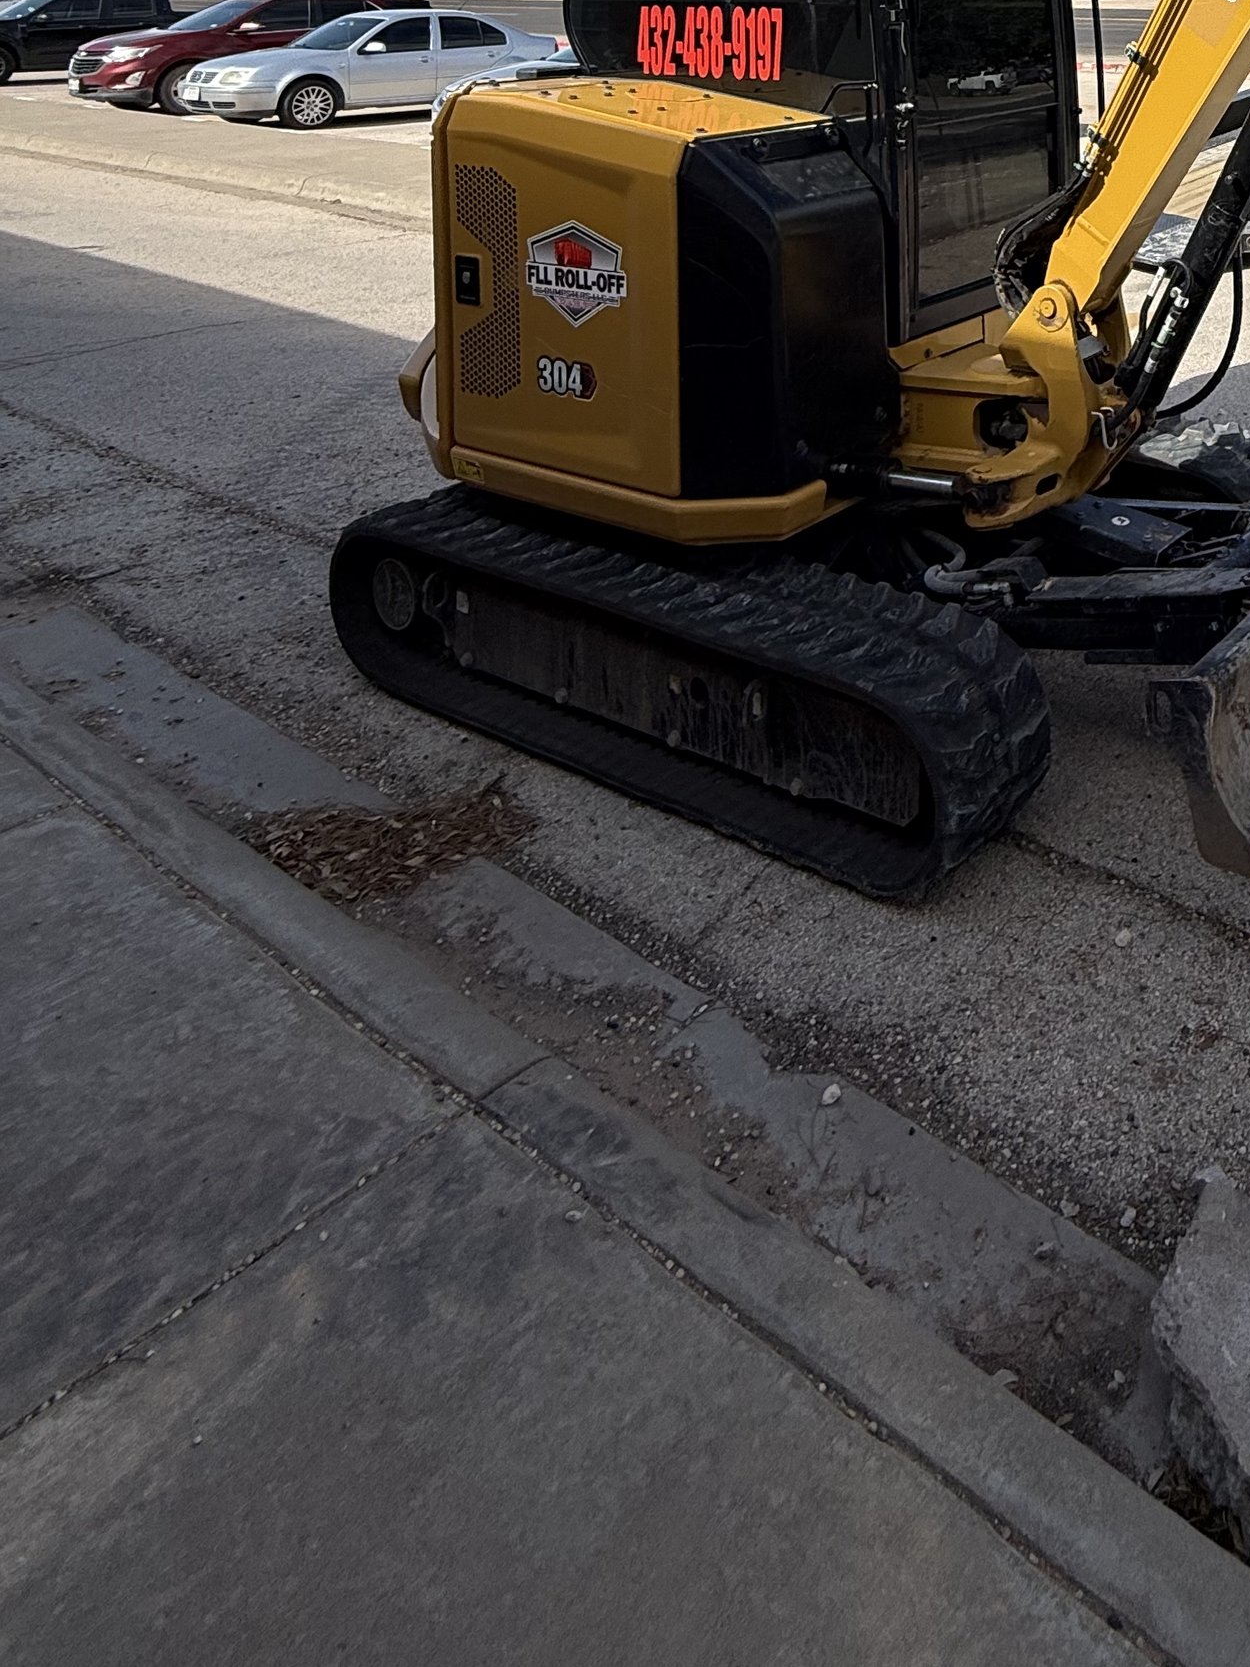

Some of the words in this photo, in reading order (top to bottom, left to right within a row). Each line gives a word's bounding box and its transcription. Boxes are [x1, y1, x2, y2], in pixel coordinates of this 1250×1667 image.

[637, 5, 783, 81] 432-438-9197
[527, 264, 553, 286] FLL
[554, 267, 626, 295] ROLL-OFF
[538, 357, 583, 396] 304
